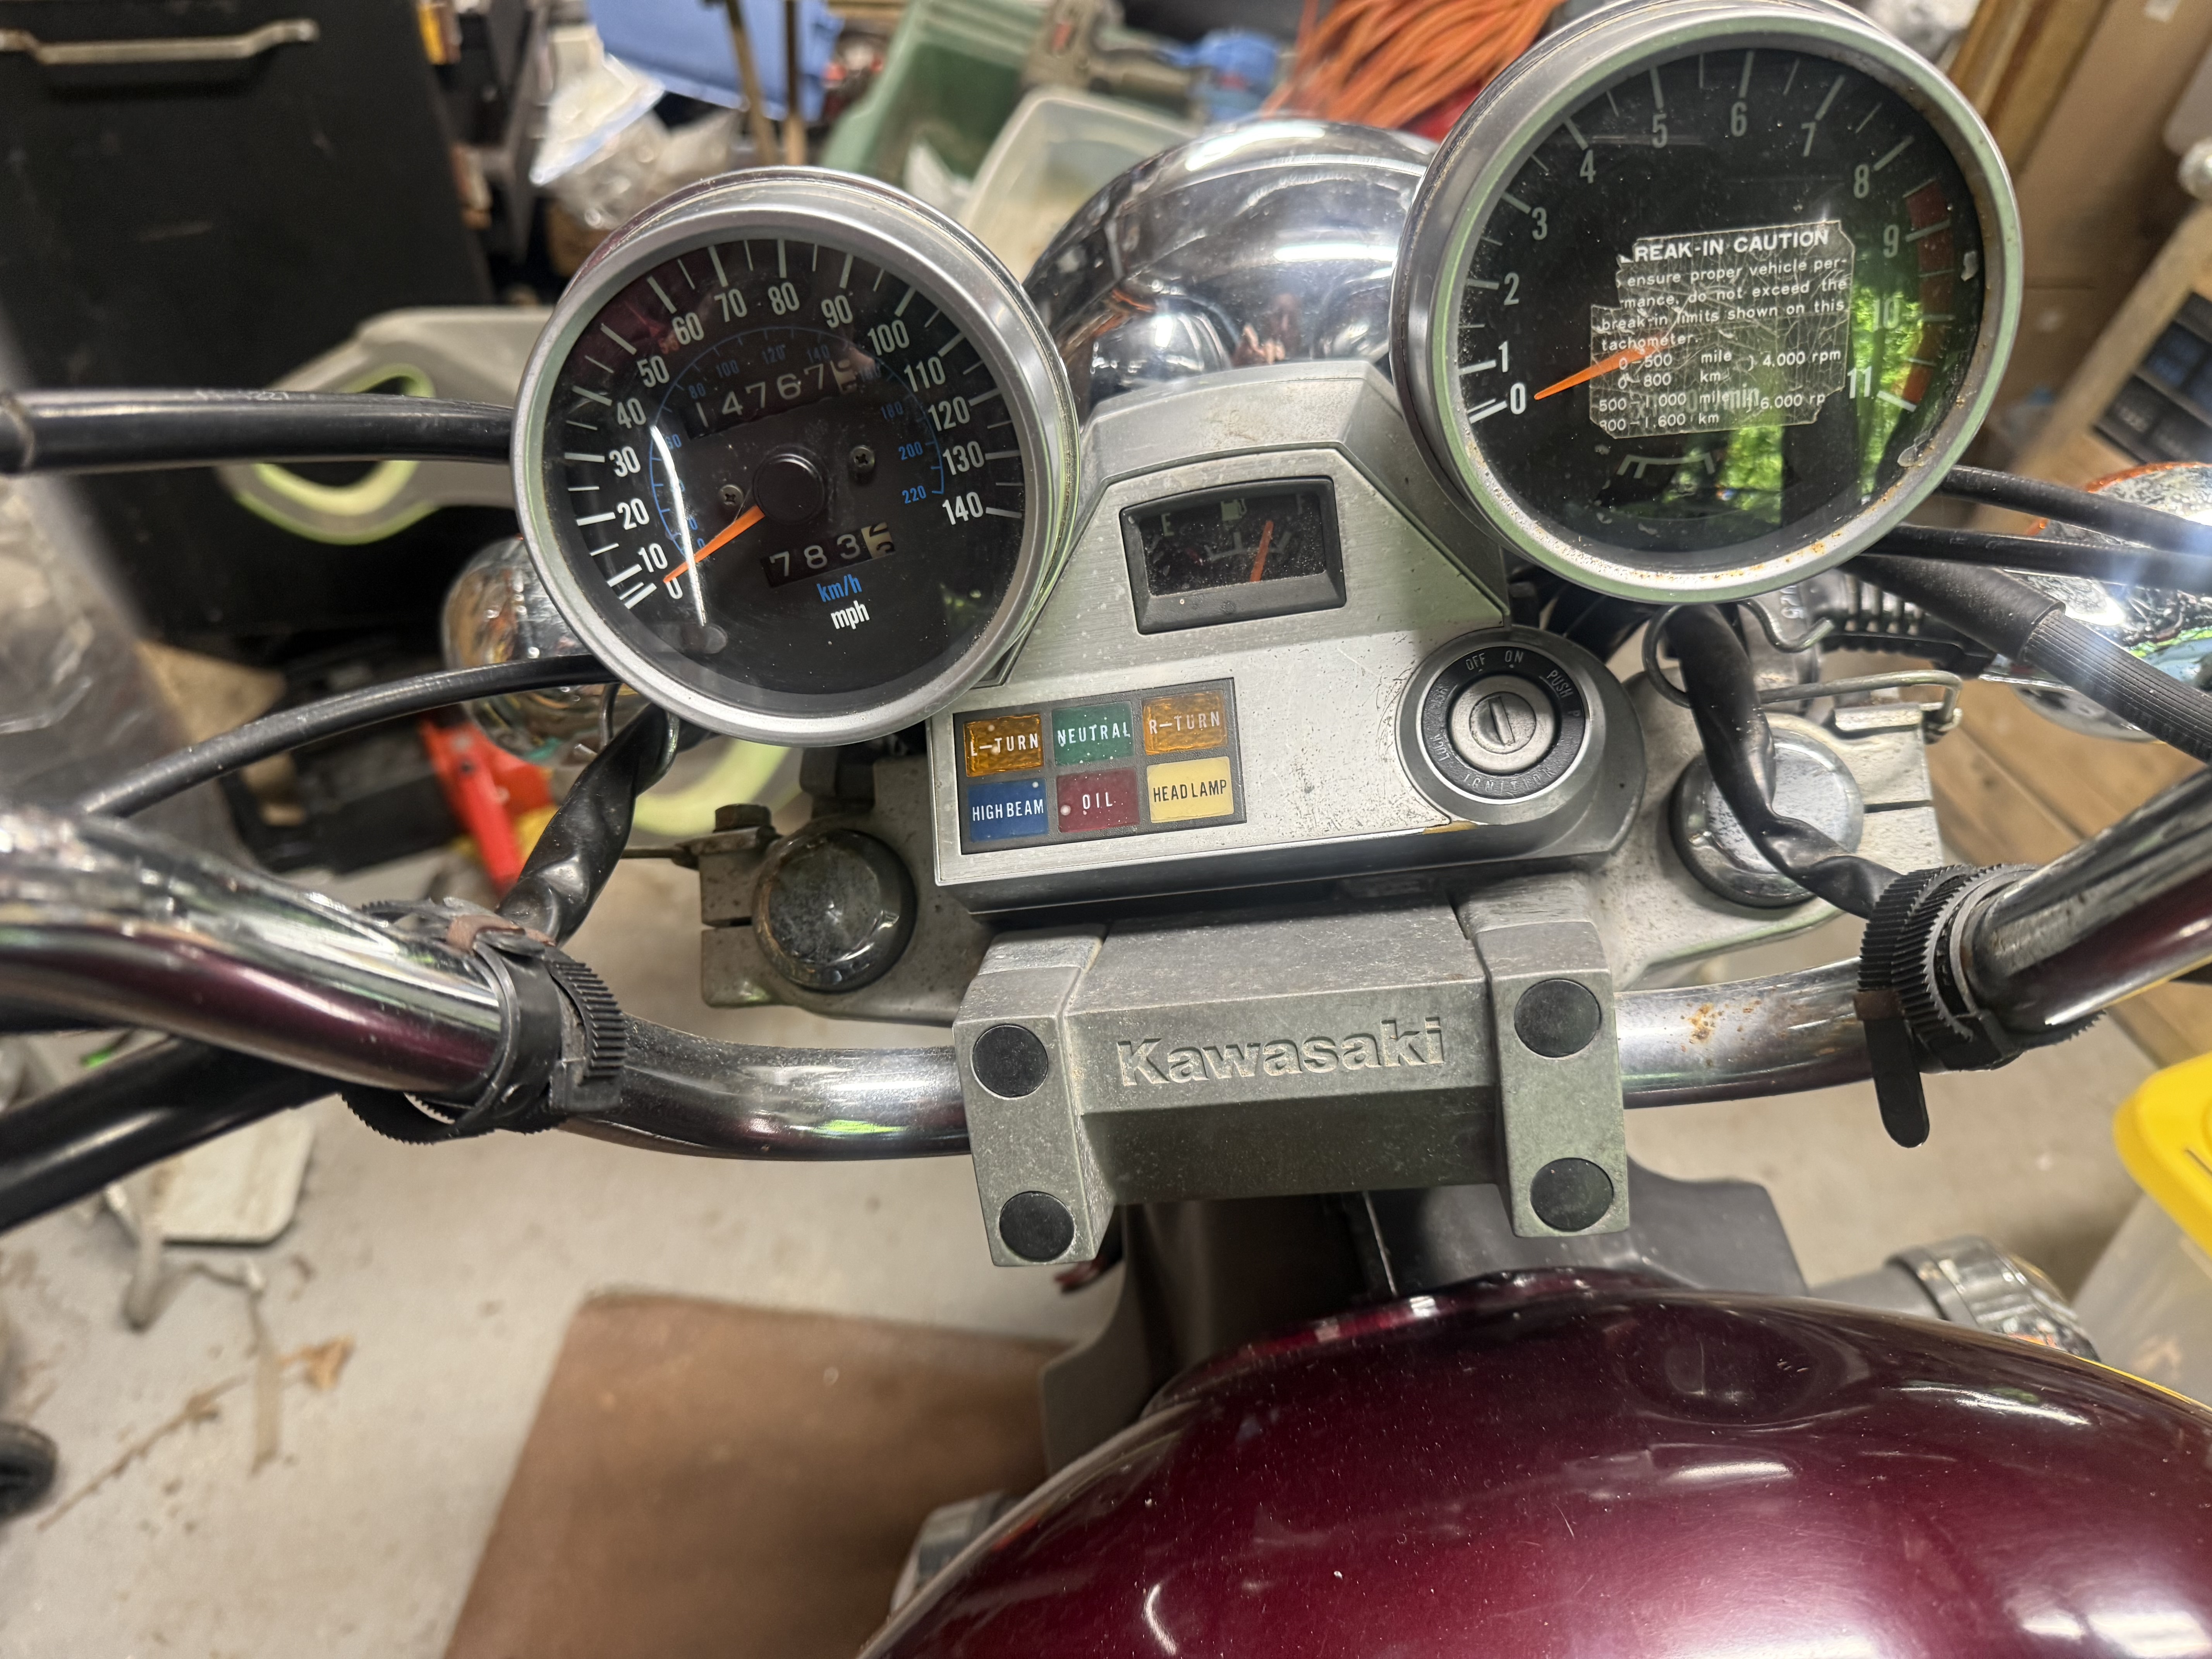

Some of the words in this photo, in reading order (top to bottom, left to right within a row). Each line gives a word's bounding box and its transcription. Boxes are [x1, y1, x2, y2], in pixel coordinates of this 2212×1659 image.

[1652, 113, 1668, 149] 5
[1731, 101, 1747, 137] 6
[1801, 122, 1817, 157] 7
[1580, 149, 1597, 184] 4
[1853, 164, 1870, 198] 8
[1532, 207, 1548, 240] 3
[1617, 239, 1723, 263] REAK-IN
[1734, 230, 1829, 254] CAUTION
[1883, 225, 1900, 259] 9
[1504, 273, 1520, 306] 2
[1627, 273, 1681, 288] ensure
[1690, 268, 1742, 284] proper
[1749, 259, 1807, 276] vehicle
[1814, 259, 1847, 273] per-
[714, 289, 747, 322] 70
[768, 282, 800, 315] 80
[1688, 290, 1707, 304] do
[1717, 289, 1743, 301] not
[1752, 283, 1810, 298] exceed
[1822, 279, 1847, 292] the
[821, 295, 852, 328] 90
[1601, 313, 1668, 331] break-in
[1676, 310, 1719, 325] limits
[1728, 305, 1778, 321] shown
[1786, 303, 1805, 316] on
[1814, 299, 1846, 313] this
[1872, 297, 1901, 332] 10
[672, 312, 704, 345] 60
[867, 319, 910, 356] 100
[1601, 332, 1698, 352] tachometer.
[716, 359, 740, 378] 100
[762, 344, 786, 364] 120
[1498, 341, 1508, 373] 1
[1701, 350, 1733, 365] mile
[1812, 350, 1841, 364] rpm
[637, 356, 670, 387] 50
[904, 357, 946, 392] 110
[1700, 370, 1722, 384] km
[1847, 365, 1873, 399] 11
[689, 383, 706, 399] 80
[1510, 382, 1526, 415] 0
[1699, 389, 1730, 403] mile
[617, 398, 646, 429] 40
[928, 396, 970, 432] 120
[1698, 412, 1719, 424] km
[609, 446, 641, 477] 30
[898, 441, 923, 460] 200
[942, 441, 984, 475] 130
[902, 485, 927, 504] 220
[942, 491, 984, 525] 140
[617, 498, 649, 530] 20
[1162, 512, 1174, 537] E
[637, 543, 668, 572] 10
[817, 574, 862, 602] km/h
[831, 600, 870, 630] mph
[1466, 653, 1486, 670] OFF
[1505, 650, 1523, 663] ON
[1547, 670, 1573, 698] PUSH
[1057, 721, 1131, 746] NEUTRAL
[1082, 792, 1113, 810] OIL
[1117, 1016, 1444, 1086] Kawasaki
